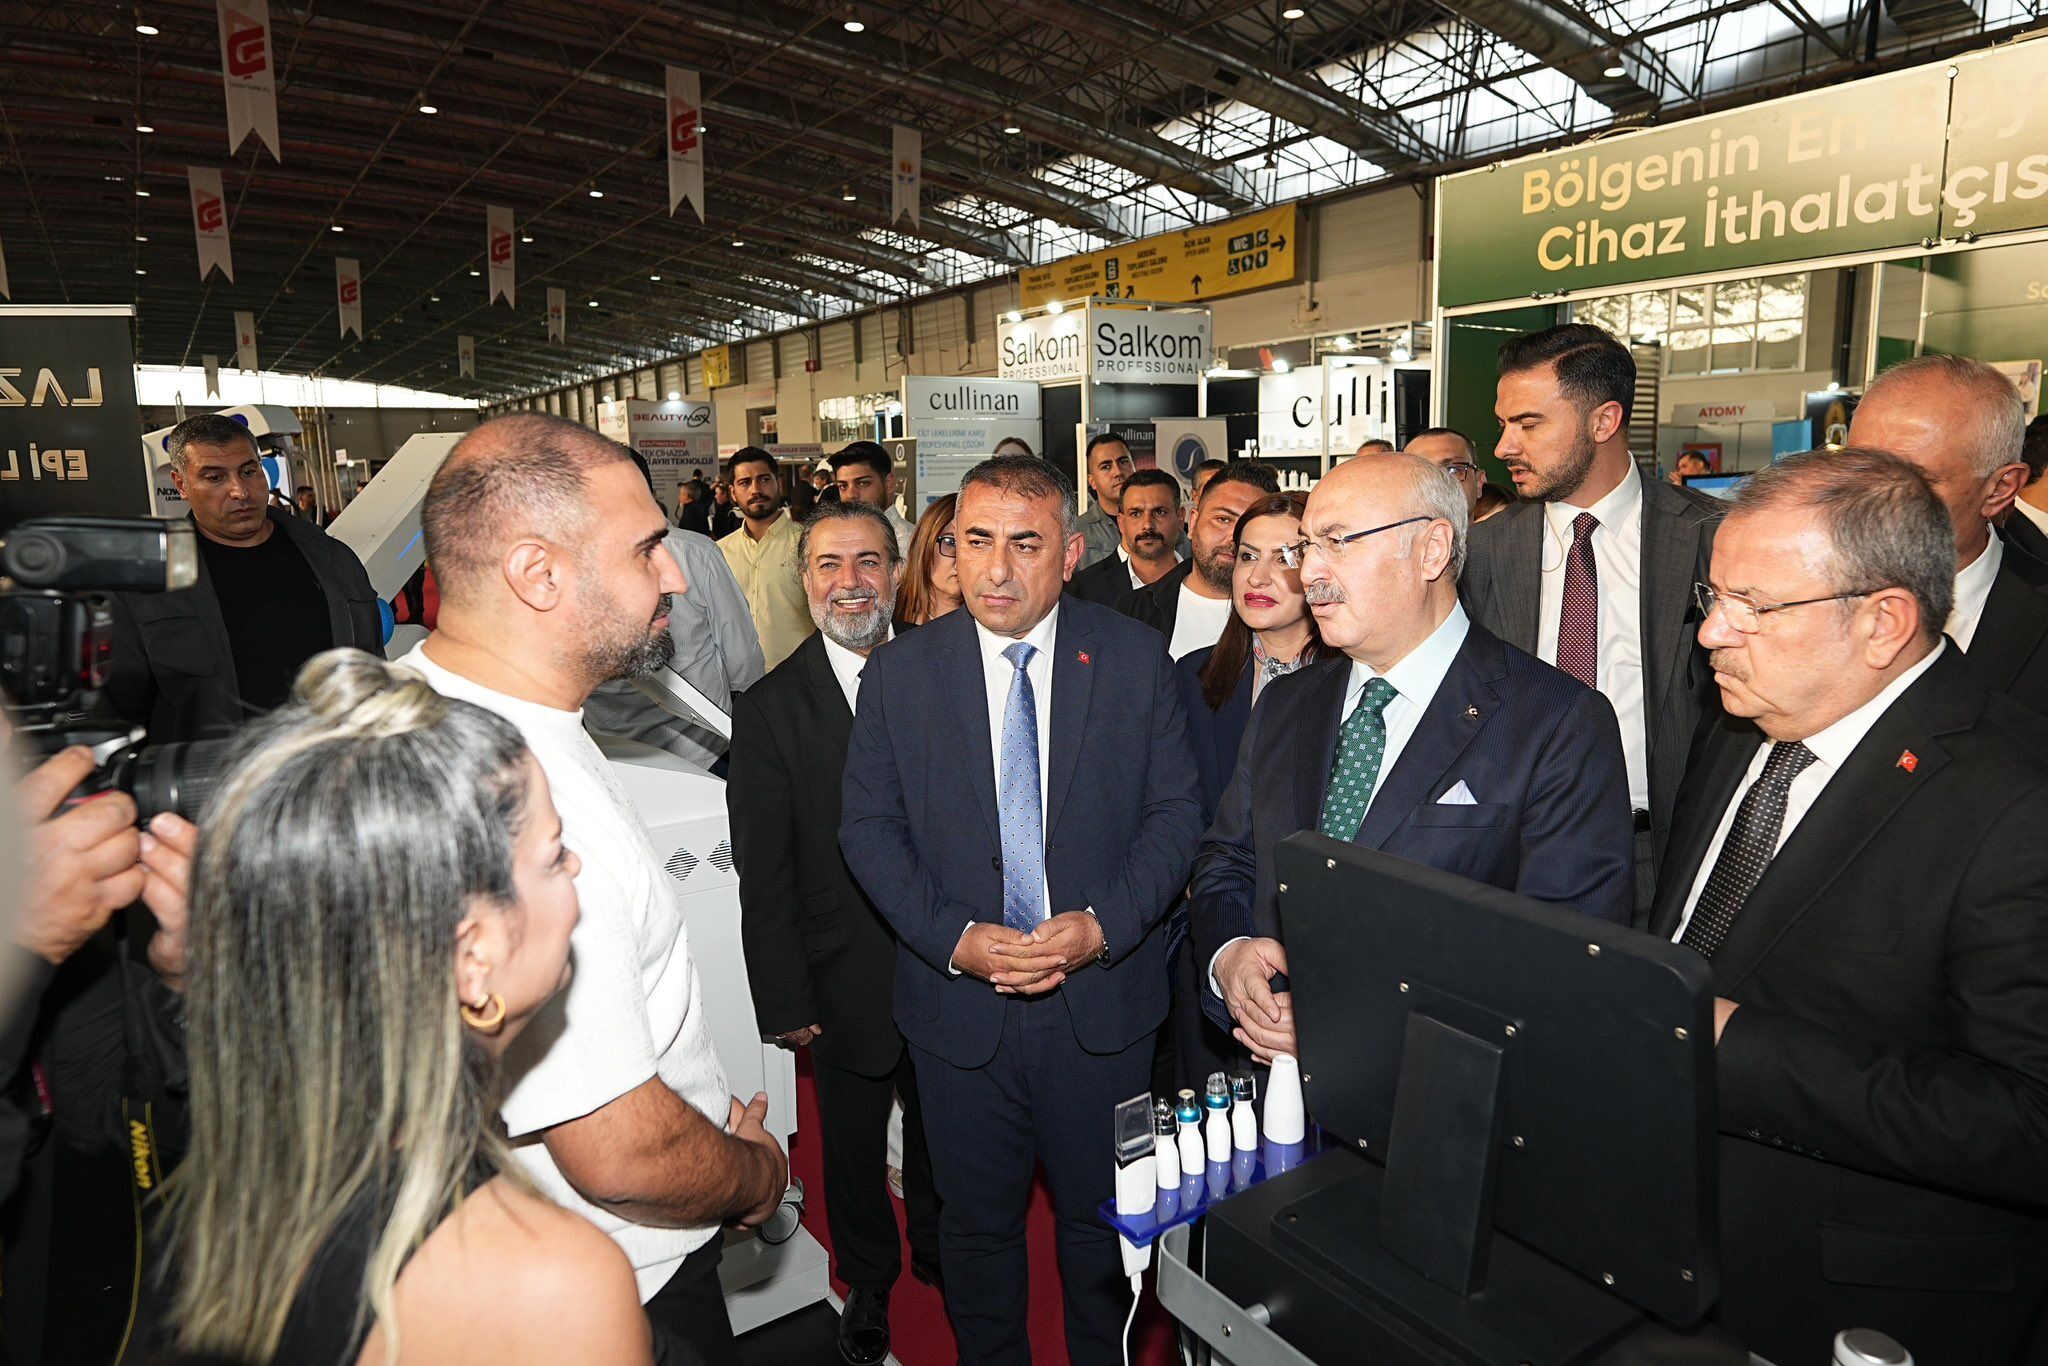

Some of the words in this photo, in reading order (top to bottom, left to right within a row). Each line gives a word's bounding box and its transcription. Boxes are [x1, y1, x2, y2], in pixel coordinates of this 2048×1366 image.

[1521, 128, 1760, 215] Bölgenin
[1787, 107, 1868, 164] En
[1233, 236, 1249, 251] WC
[1537, 216, 1687, 271] Cihaz
[1003, 332, 1080, 367] Salkom
[1097, 322, 1202, 359] Salkom
[1003, 362, 1080, 380] PROFESSIONAL
[1097, 359, 1200, 375] PROFESSIONAL
[929, 386, 1019, 411] cullinan
[1699, 405, 1746, 418] ATOMY
